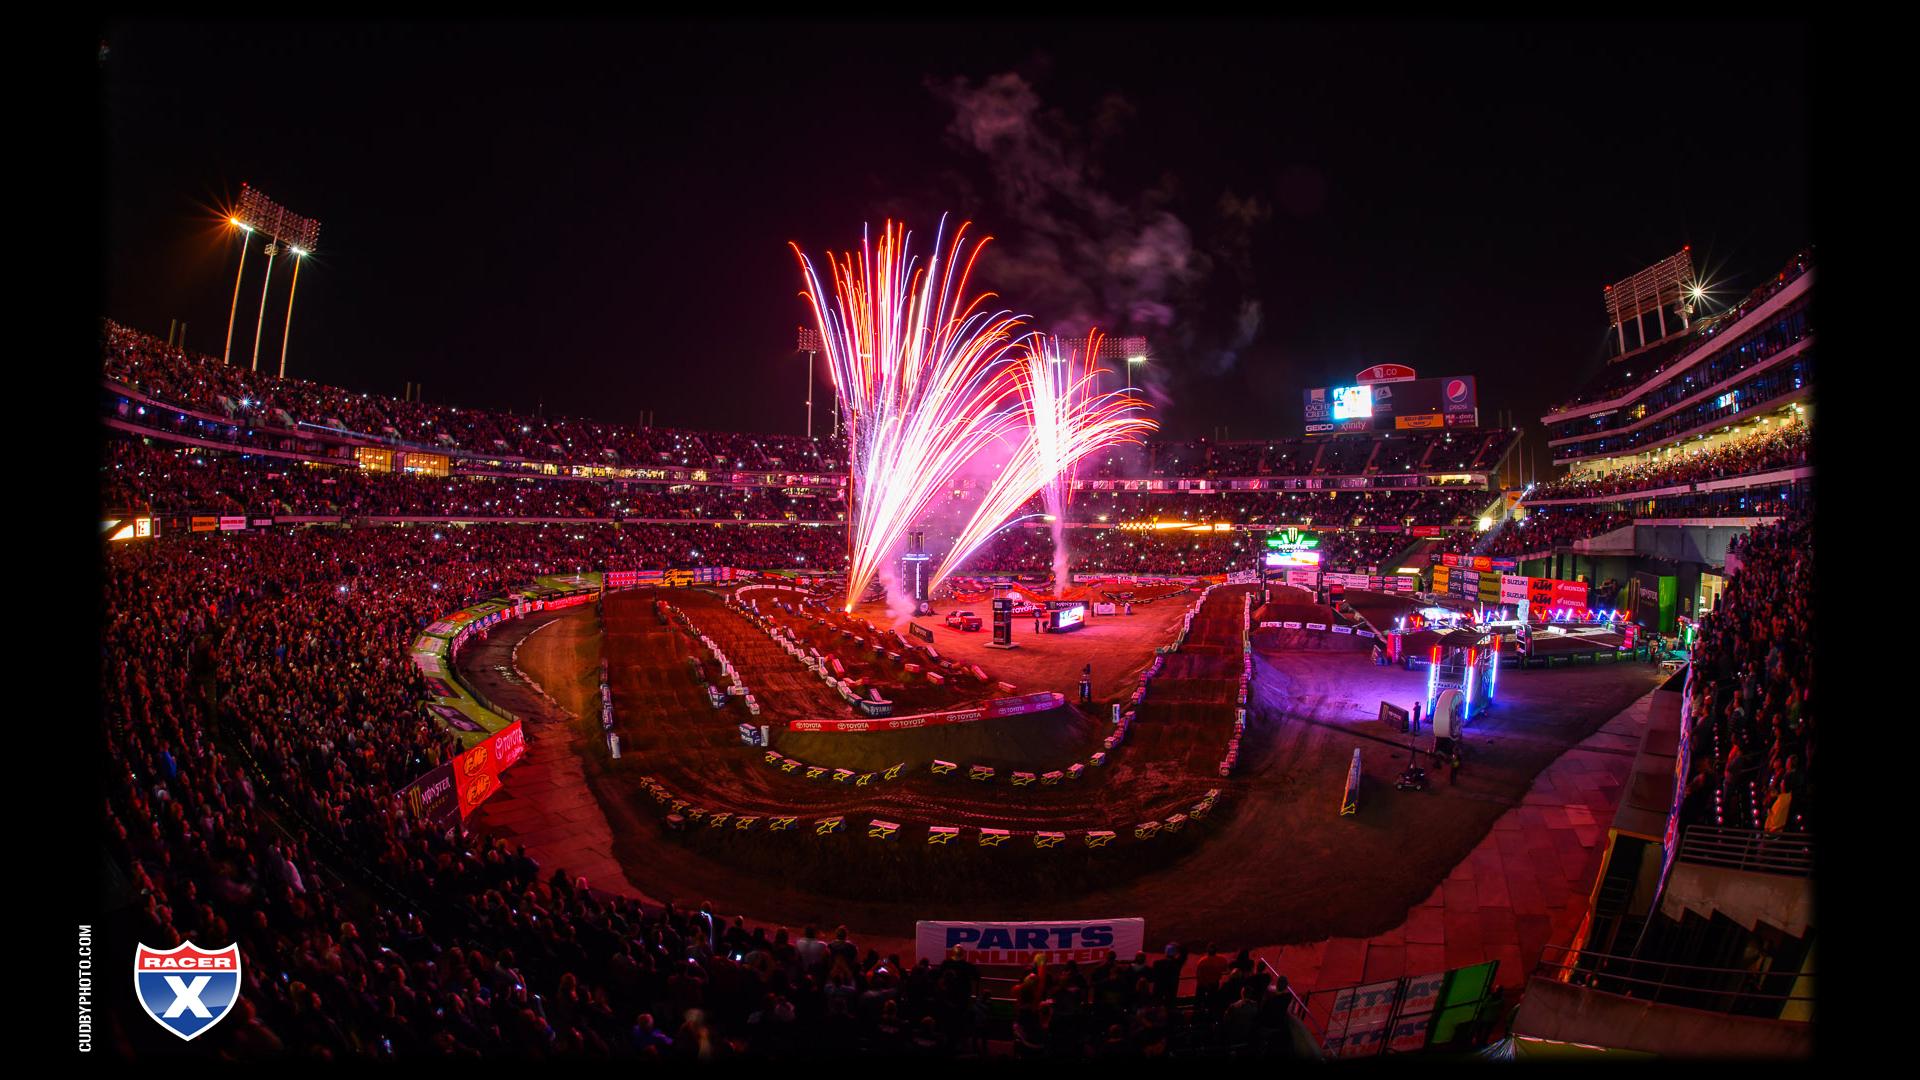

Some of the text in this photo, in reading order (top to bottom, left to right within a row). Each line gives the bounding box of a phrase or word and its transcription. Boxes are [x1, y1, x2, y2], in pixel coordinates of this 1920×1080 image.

[1305, 424, 1334, 432] GEICO
[1507, 578, 1528, 586] SUZUKI
[1533, 580, 1553, 590] KTM
[1506, 591, 1527, 599] SUZUKI
[1533, 594, 1552, 604] KTM
[1011, 604, 1038, 614] TOYOTA
[957, 712, 982, 721] TOYOTA
[900, 718, 925, 727] TOYOTA
[503, 728, 525, 750] TOYOTA
[421, 777, 450, 805] MONSTER
[946, 927, 1113, 949] PARTS
